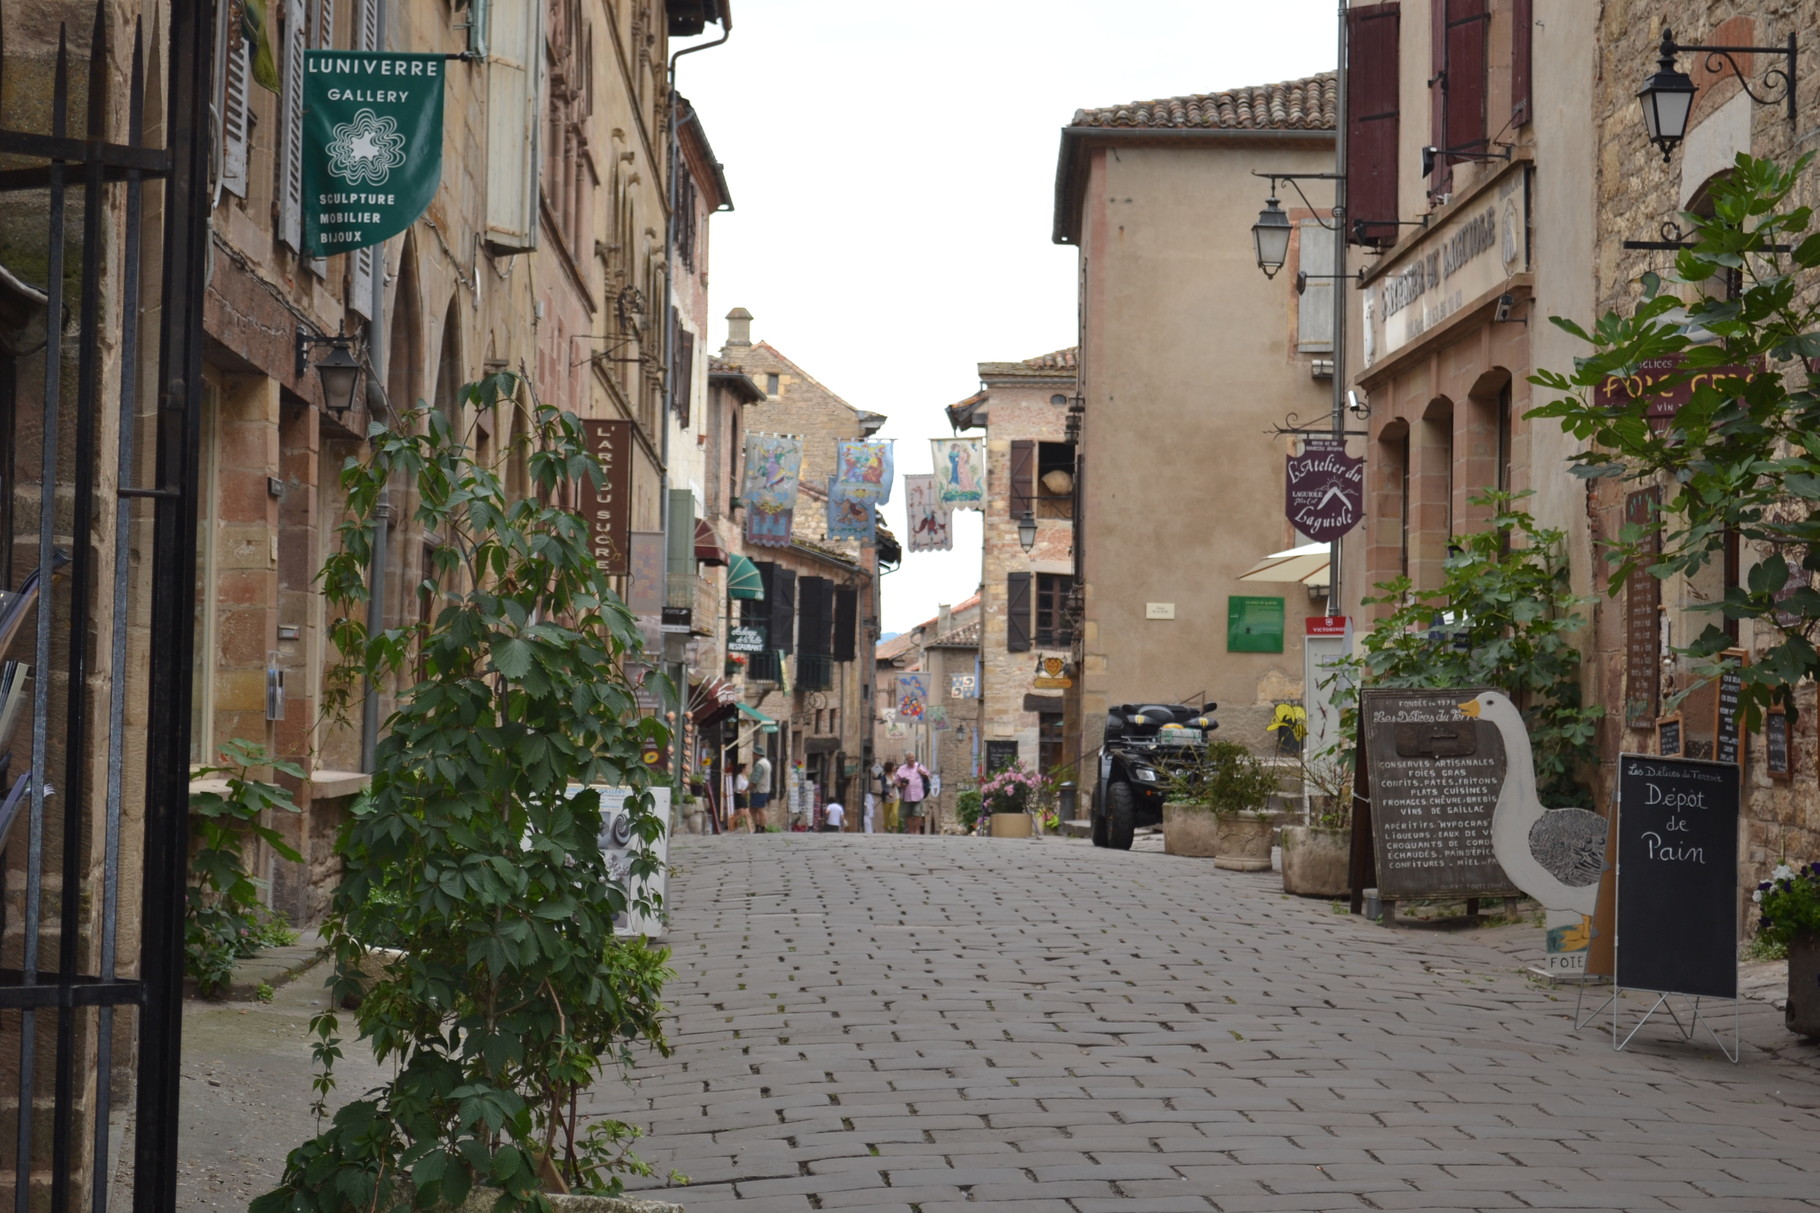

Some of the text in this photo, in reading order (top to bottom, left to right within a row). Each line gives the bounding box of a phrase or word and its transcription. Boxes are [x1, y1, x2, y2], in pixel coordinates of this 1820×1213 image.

[308, 58, 438, 76] LUNIVERRE
[327, 88, 409, 103] GALLERY
[319, 194, 395, 205] SCULPTURE
[320, 213, 381, 224] MOBILIER
[320, 231, 362, 244] BIJOUX
[1288, 454, 1363, 484] L'Atelier du
[1294, 505, 1352, 534] Laguiole
[595, 510, 612, 570] SUCRE
[728, 643, 764, 651] RESTAURANT
[1373, 711, 1396, 722] Les
[1436, 709, 1450, 721] du
[1378, 760, 1430, 769] CONSERVES
[1628, 763, 1644, 776] Les
[1645, 766, 1680, 778] Délices
[1681, 769, 1690, 778] du
[1408, 769, 1436, 777] FOIES
[1411, 788, 1438, 796] PLATS
[1644, 782, 1709, 813] Dépôt
[1400, 807, 1422, 816] VINS
[1431, 807, 1441, 815] DE
[1665, 815, 1690, 832] de
[1439, 829, 1459, 837] EAUX
[1465, 829, 1476, 837] DE
[1386, 841, 1443, 850] CROQUANTS
[1641, 831, 1706, 864] Pain
[1389, 859, 1445, 869] CONFITURES
[1549, 956, 1584, 969] FOIE
